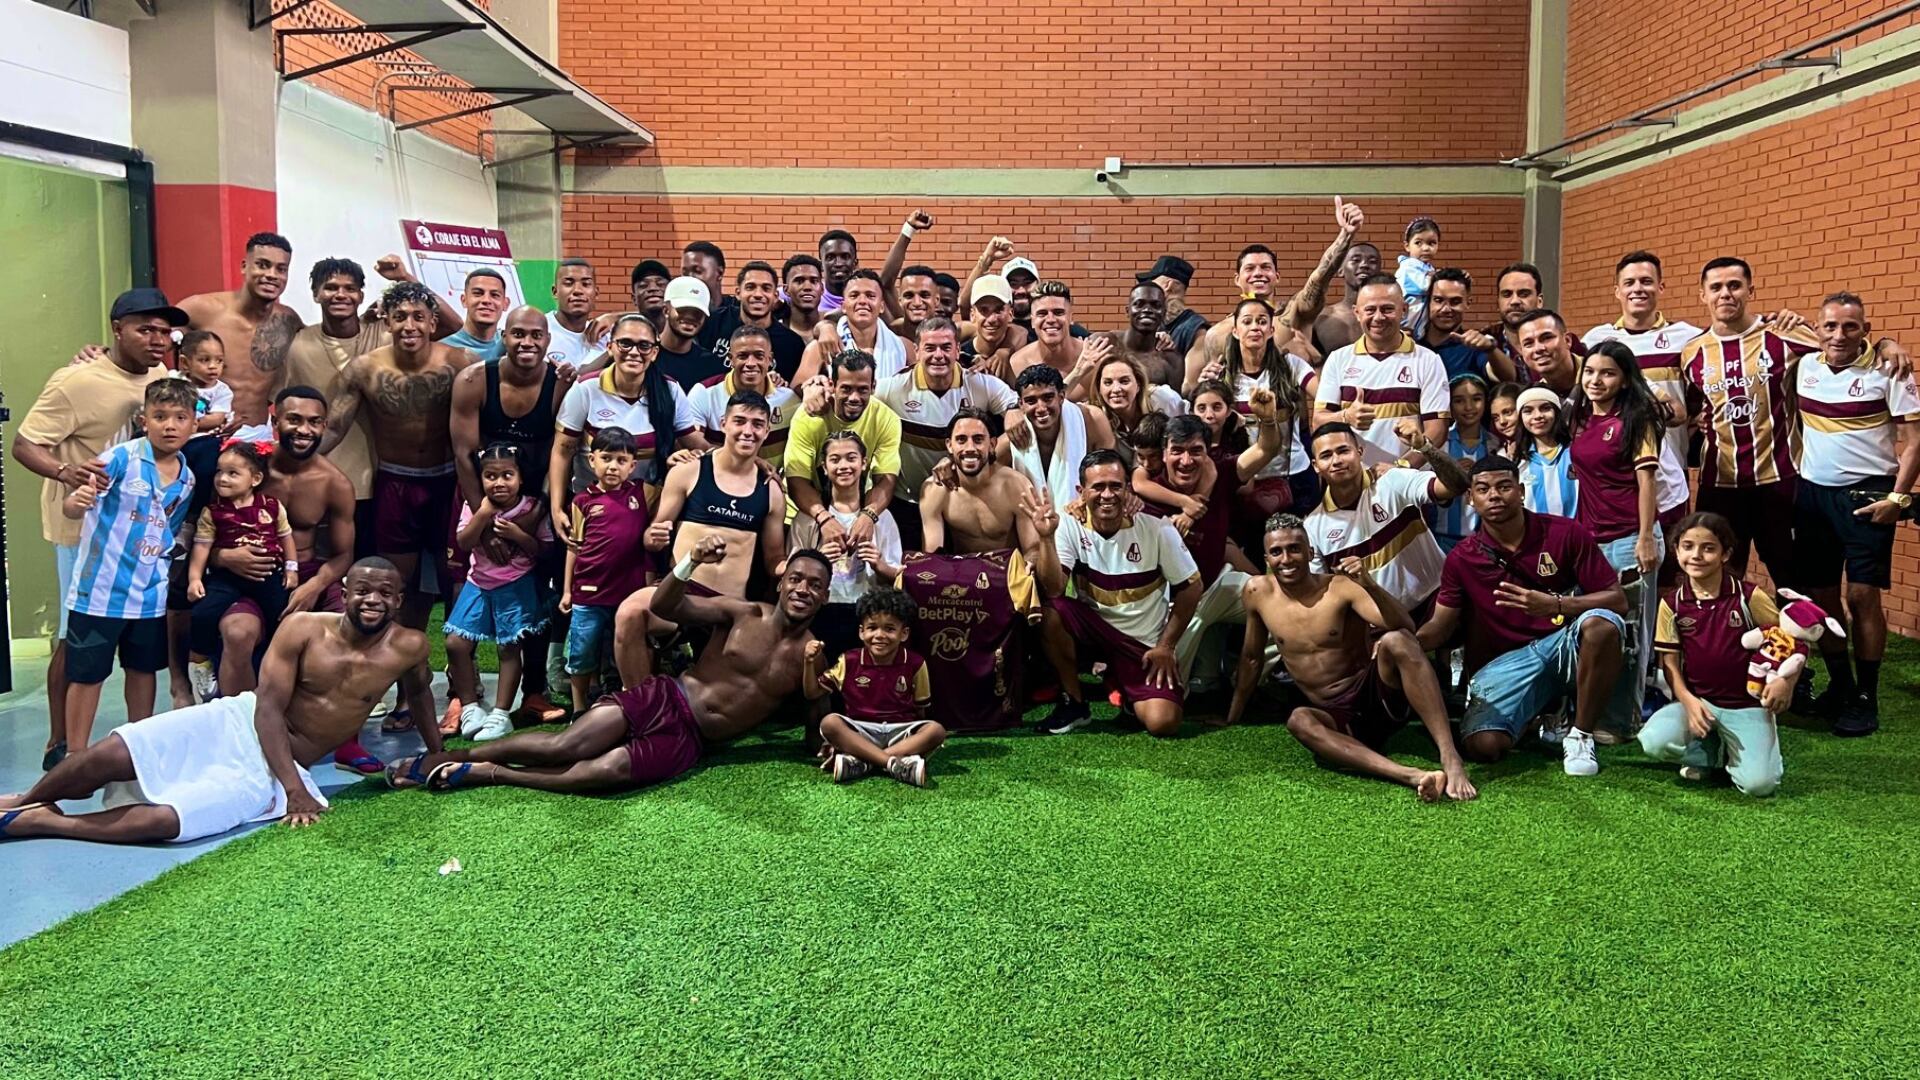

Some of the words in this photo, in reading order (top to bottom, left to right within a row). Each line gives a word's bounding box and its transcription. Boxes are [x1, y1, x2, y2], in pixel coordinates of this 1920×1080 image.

[434, 231, 462, 246] CORAJE
[460, 234, 472, 247] EN
[470, 235, 482, 248] EL
[480, 236, 501, 250] ALMA
[1726, 360, 1740, 373] PF
[1703, 375, 1755, 395] BetPlay
[1724, 393, 1758, 421] Pool
[707, 505, 755, 522] CATAPULT
[918, 606, 974, 624] BetPlay
[930, 628, 971, 656] Pool
